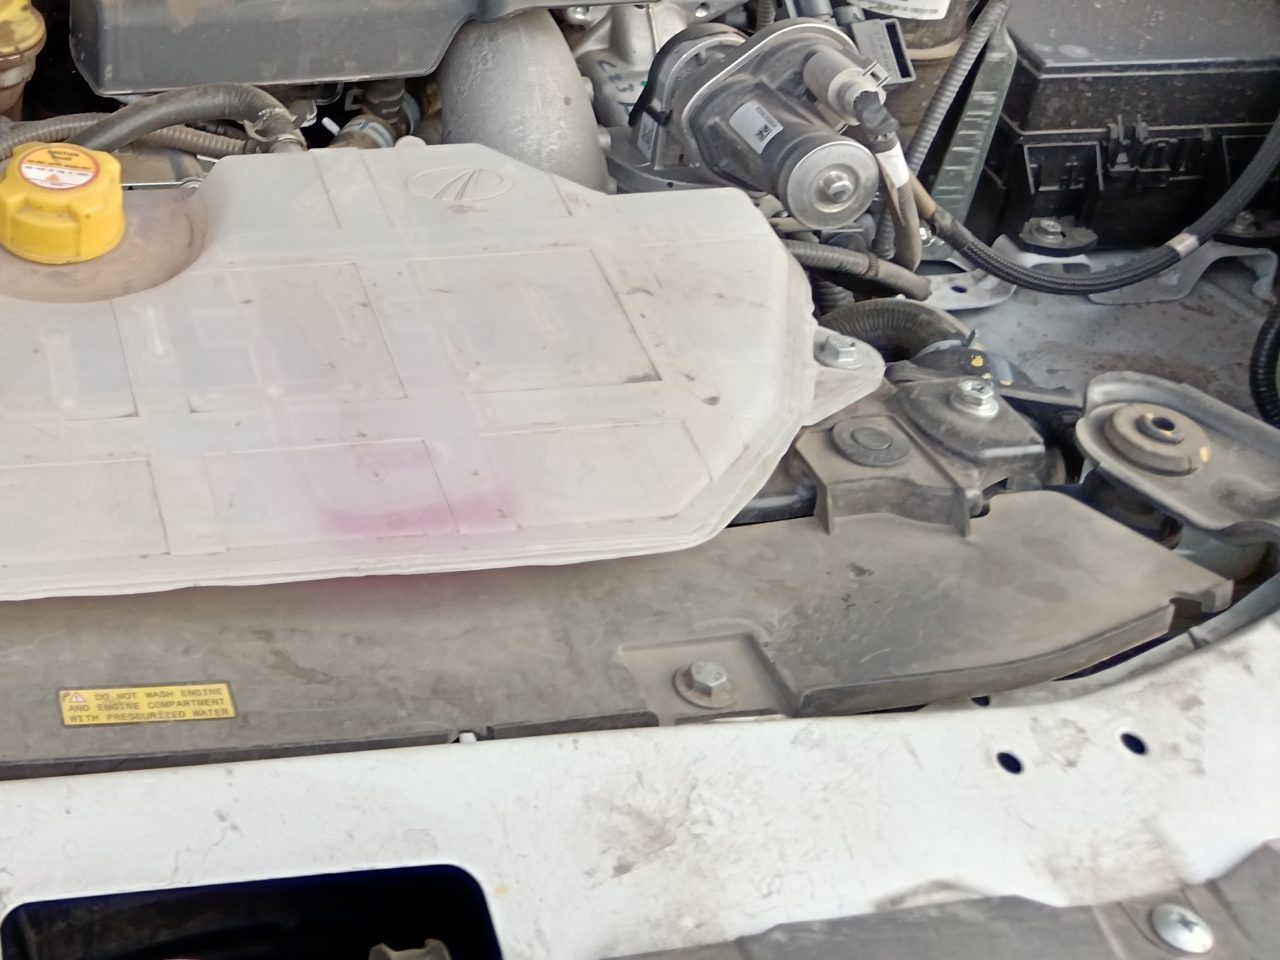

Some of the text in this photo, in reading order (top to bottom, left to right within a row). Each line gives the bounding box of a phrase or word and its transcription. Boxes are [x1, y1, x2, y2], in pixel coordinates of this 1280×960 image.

[95, 687, 224, 701] DO NOT WASH ENGINE
[68, 698, 225, 713] AND ENGINE COMPARTMENT
[70, 714, 100, 723] WITH
[191, 707, 229, 717] WATER
